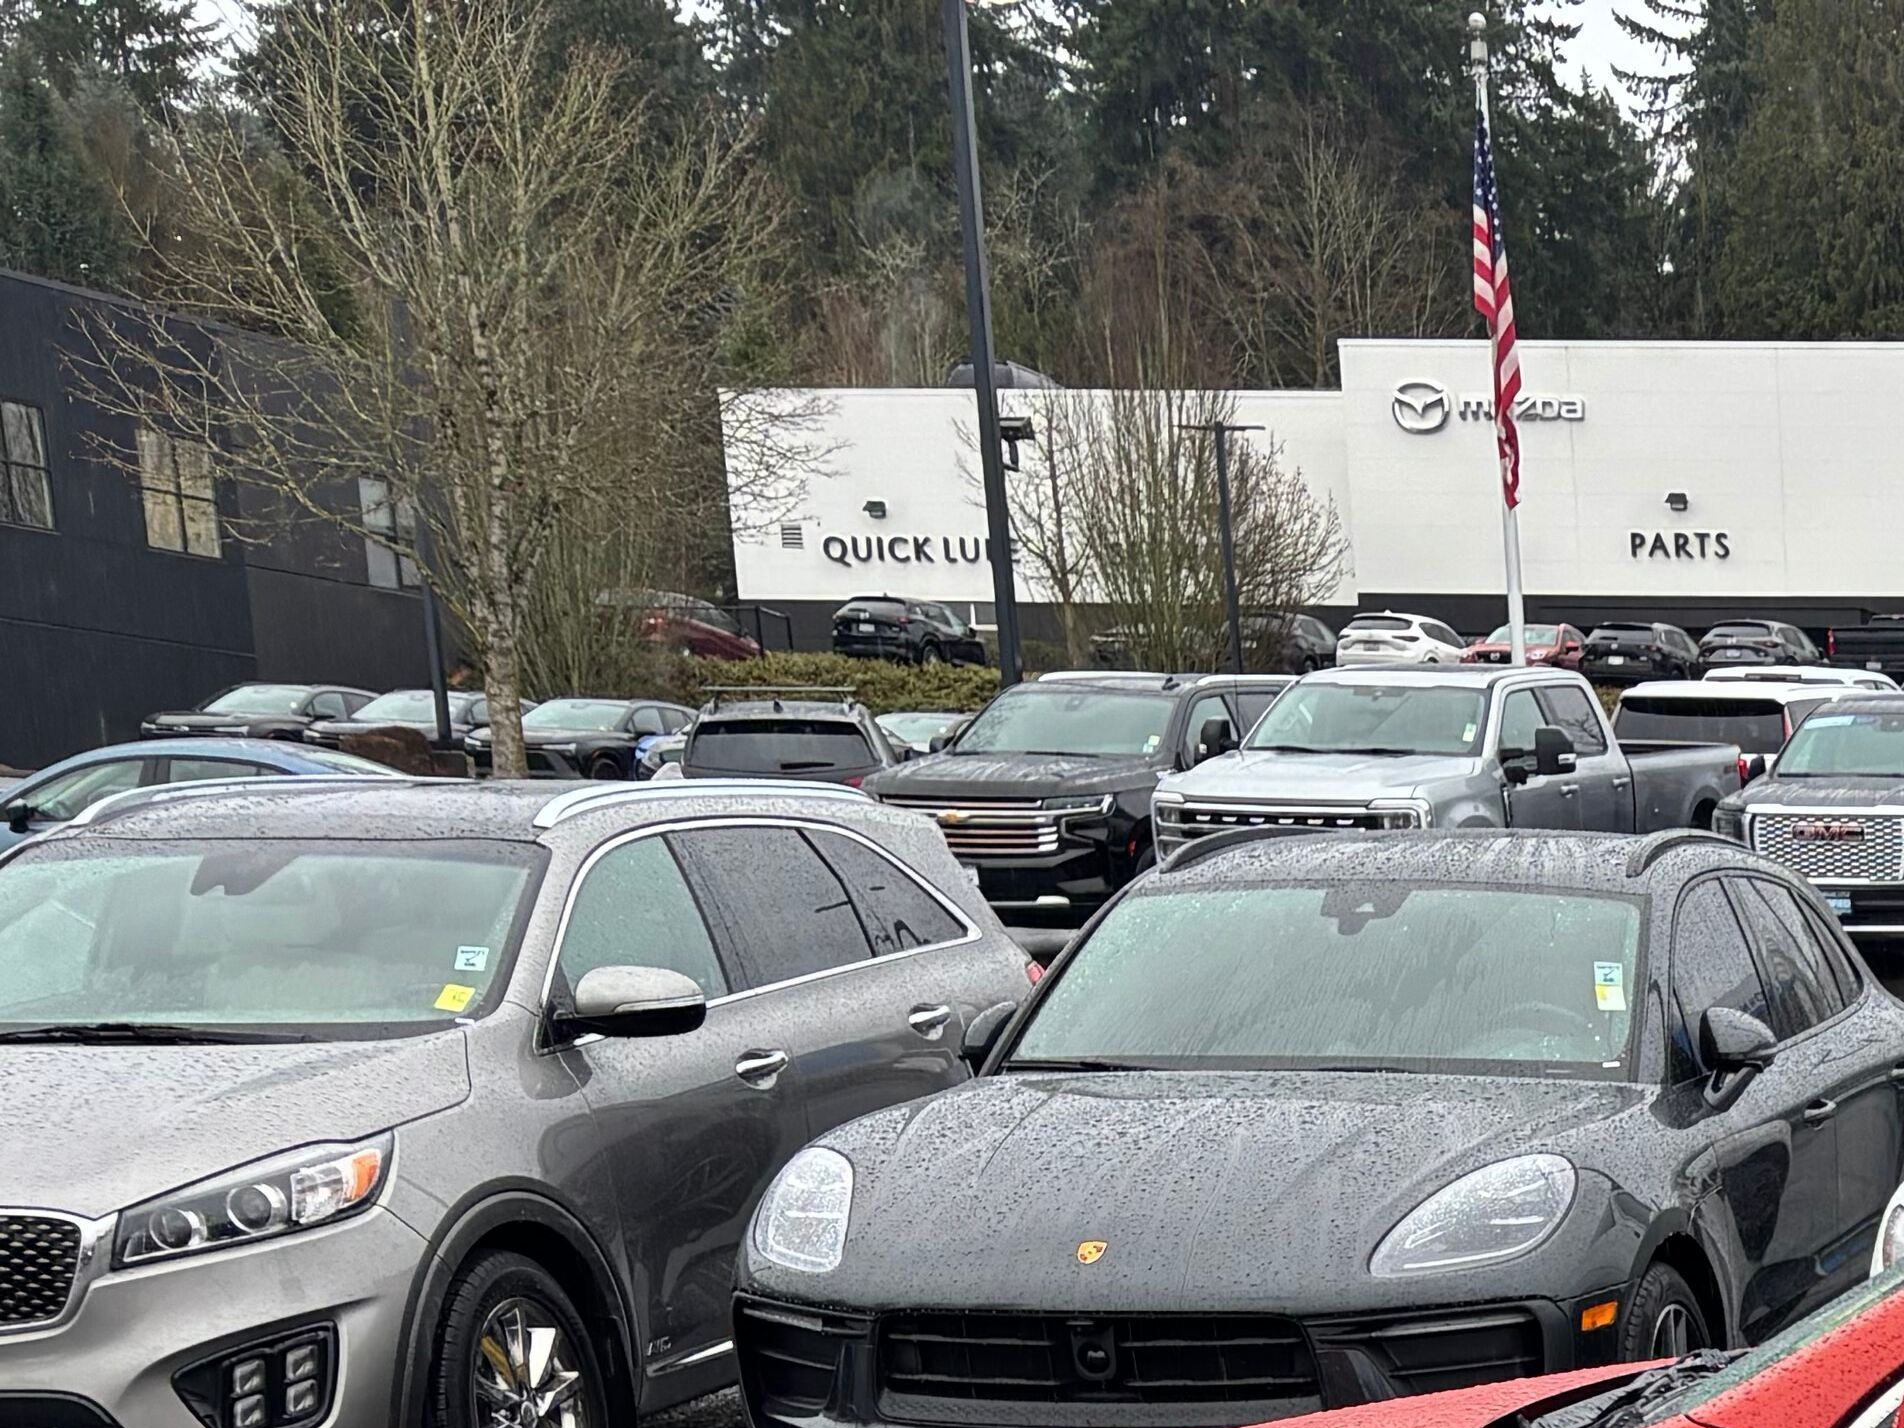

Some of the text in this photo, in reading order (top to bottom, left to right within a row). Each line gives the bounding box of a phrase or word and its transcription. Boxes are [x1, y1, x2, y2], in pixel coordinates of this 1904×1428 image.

[1457, 393, 1586, 422] mzda
[823, 536, 935, 567] QUICK
[1630, 532, 1730, 559] PARTS
[1793, 825, 1863, 842] GMC
